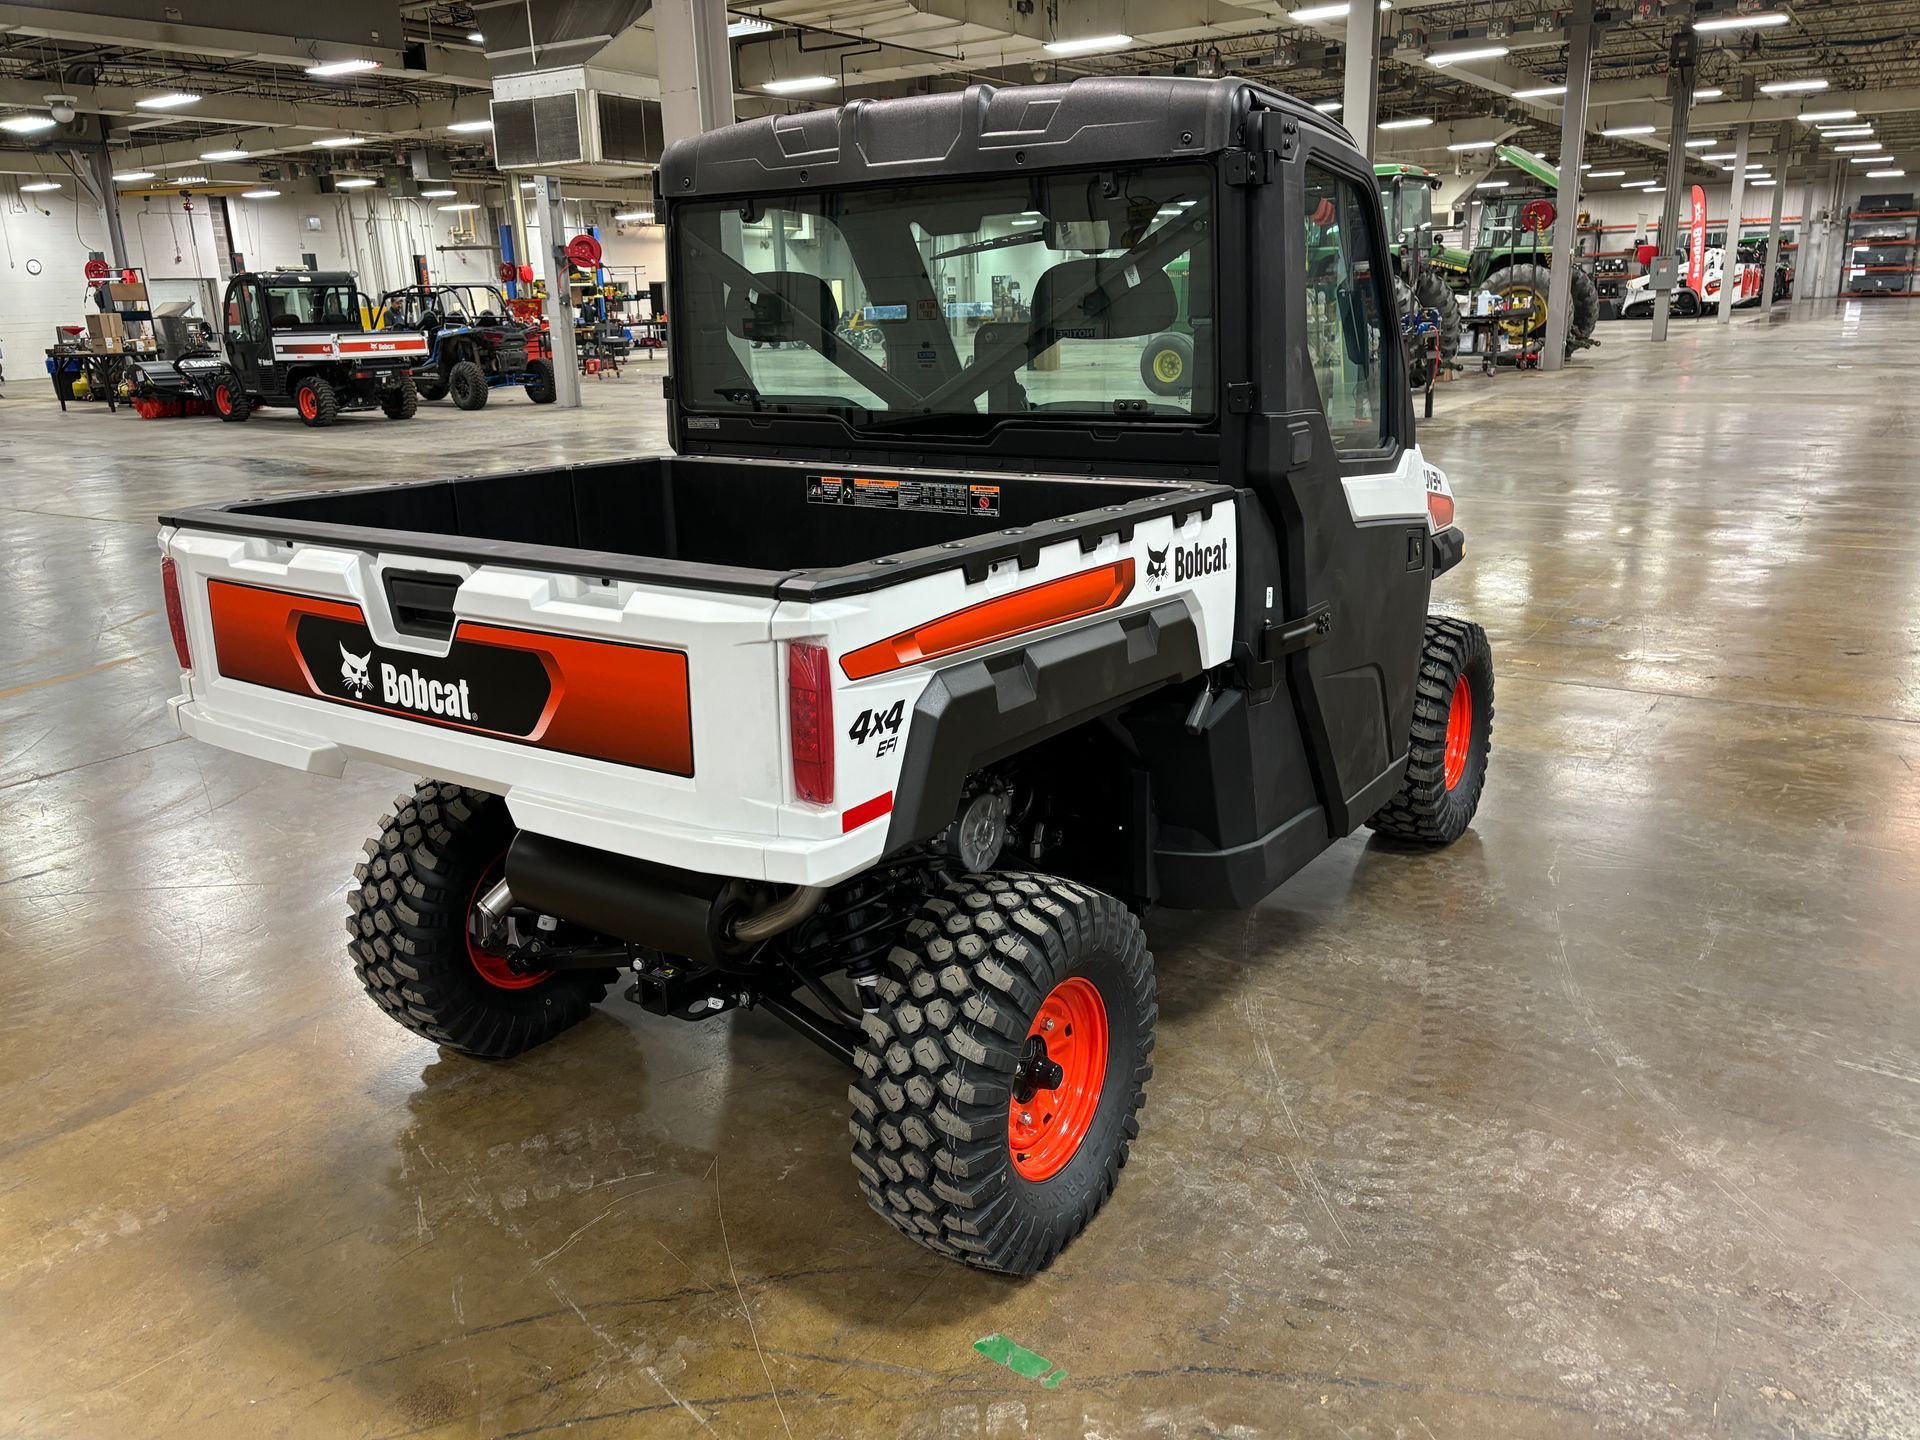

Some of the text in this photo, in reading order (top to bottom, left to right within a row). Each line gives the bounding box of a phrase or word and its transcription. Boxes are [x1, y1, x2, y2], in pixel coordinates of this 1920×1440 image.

[1174, 537, 1228, 583] Bobcat
[380, 662, 472, 721] Bobcat
[848, 699, 906, 746] 4x4
[875, 735, 899, 759] EFI
